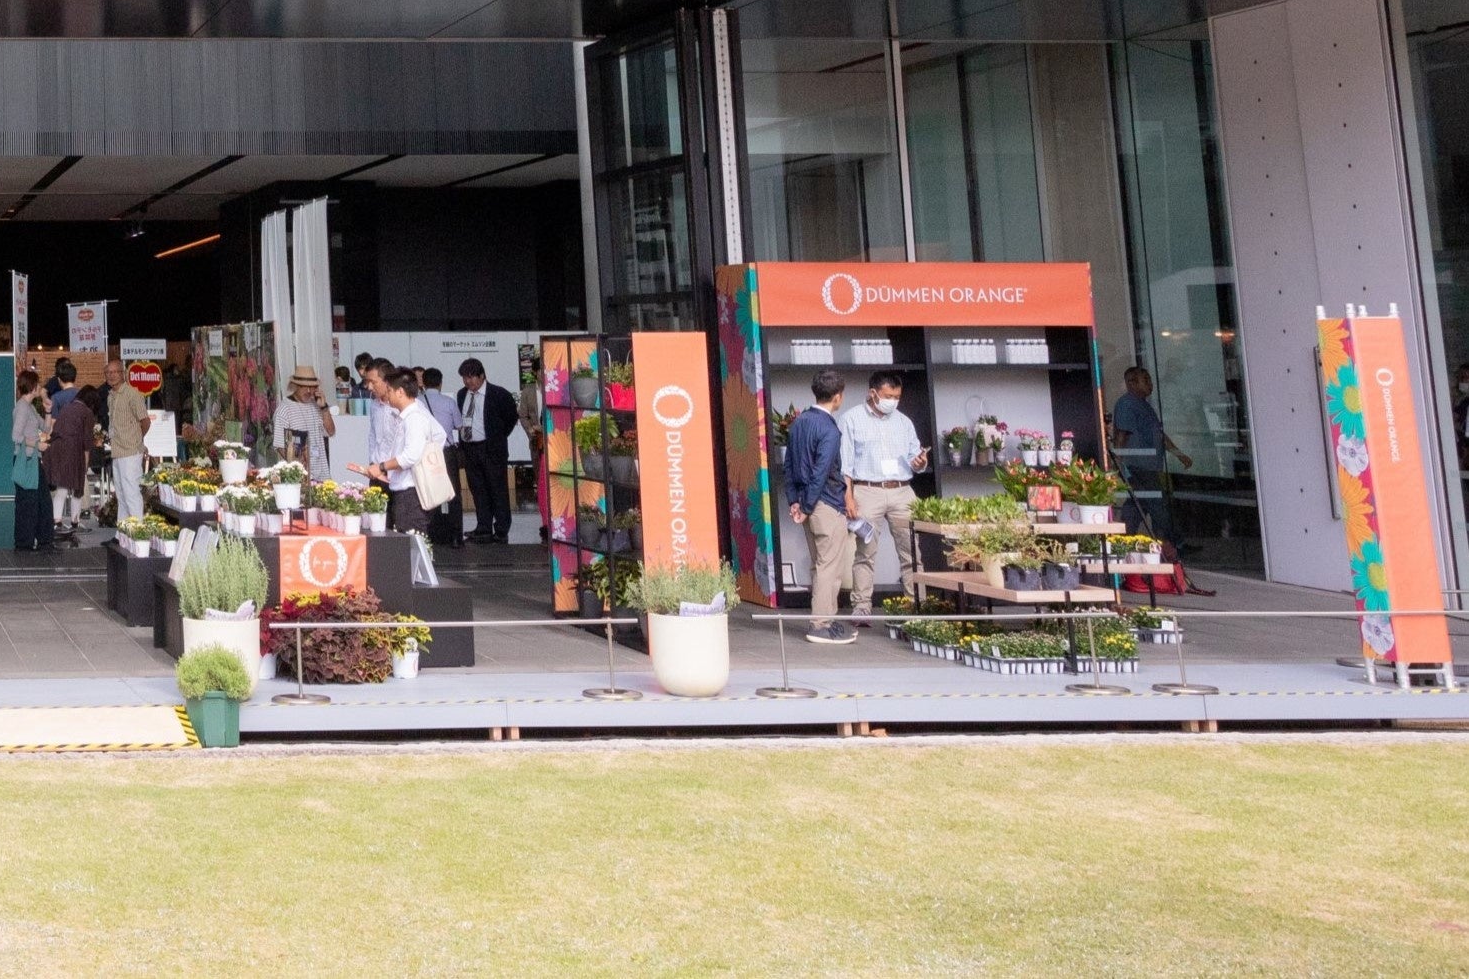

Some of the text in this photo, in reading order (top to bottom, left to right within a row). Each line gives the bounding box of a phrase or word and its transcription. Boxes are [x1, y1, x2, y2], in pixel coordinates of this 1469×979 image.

[866, 285, 944, 303] DÜMMEN
[130, 372, 161, 382] Del Monte
